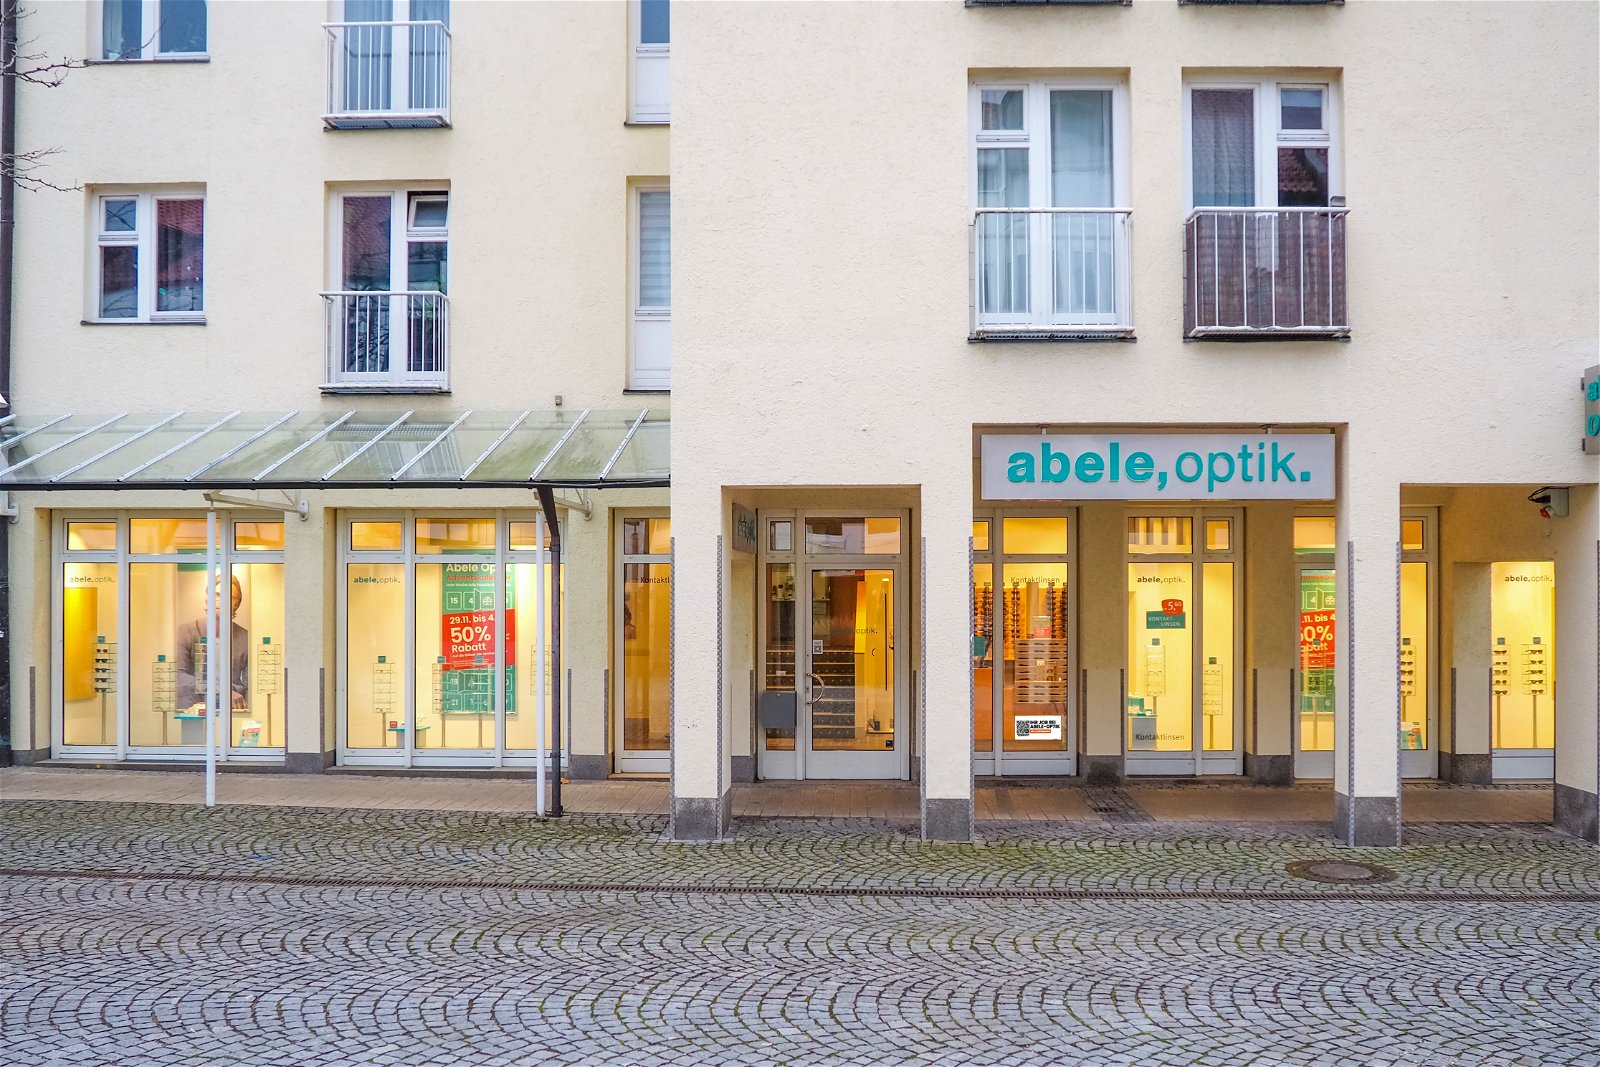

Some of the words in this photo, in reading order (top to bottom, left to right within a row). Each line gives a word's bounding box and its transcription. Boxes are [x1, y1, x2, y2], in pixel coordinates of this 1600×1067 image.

[473, 614, 487, 623] bis
[1314, 613, 1329, 623] bis
[450, 625, 492, 643] 50%
[451, 643, 487, 653] Rabatt
[1135, 733, 1185, 741] Kontaktlinsen
